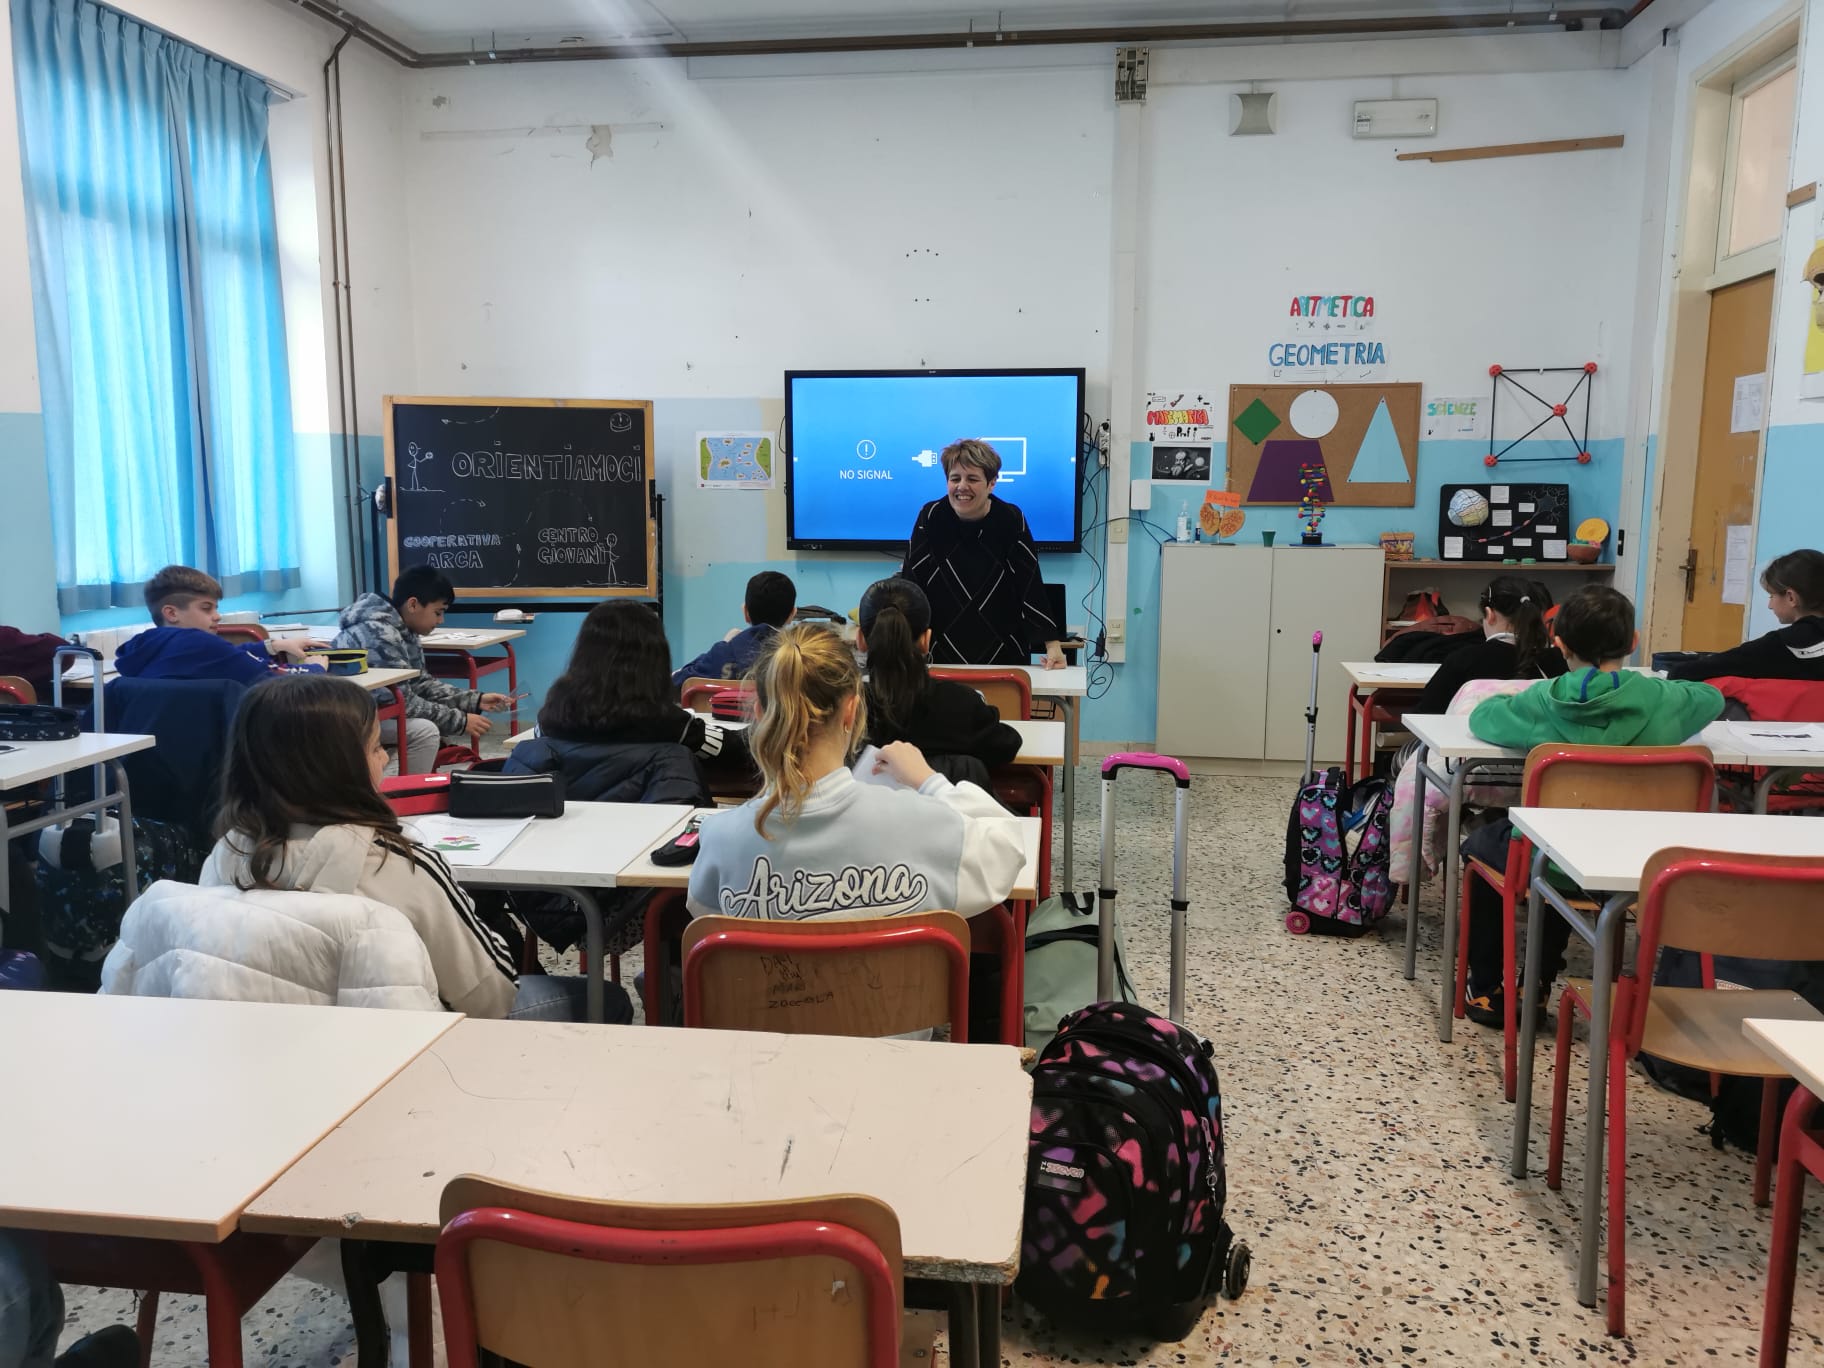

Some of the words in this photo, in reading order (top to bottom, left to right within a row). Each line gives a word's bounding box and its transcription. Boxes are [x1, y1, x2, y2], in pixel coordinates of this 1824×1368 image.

[1268, 342, 1386, 367] GEOMETRIA
[1146, 408, 1209, 426] MATEMATICA
[451, 441, 642, 483] ORIENTIAMOCI
[840, 469, 855, 480] NO
[857, 469, 894, 480] SIGNAL
[403, 533, 502, 549] COOPERATIVA
[538, 526, 599, 543] CENTRO
[426, 550, 484, 569] ARCA
[537, 544, 607, 565] GIOVANI
[720, 857, 929, 920] Arizona
